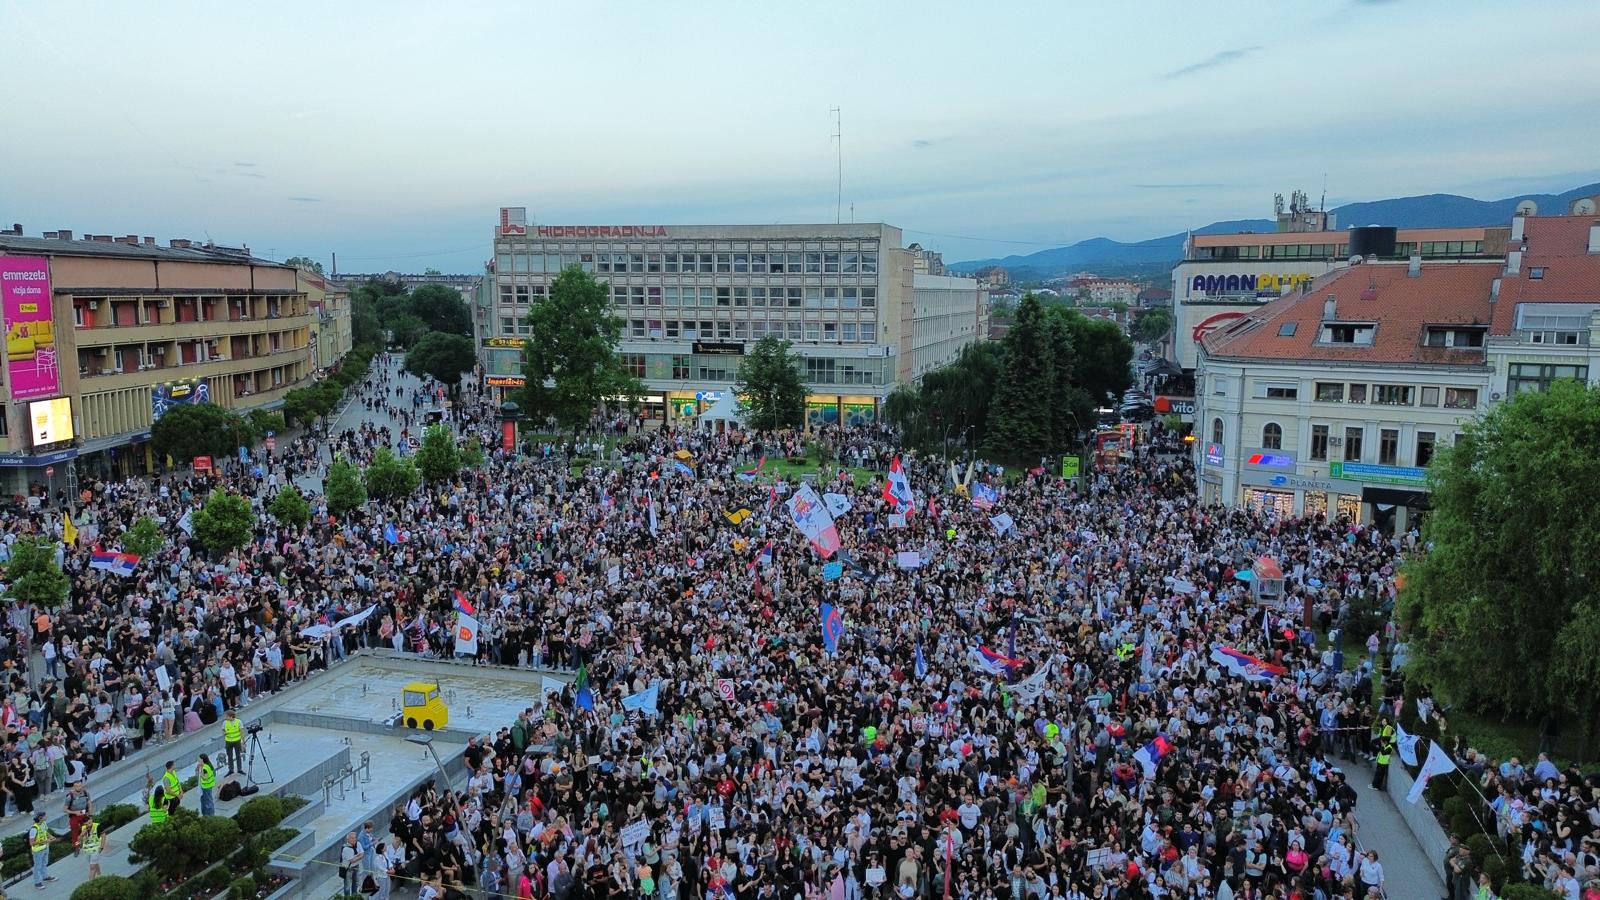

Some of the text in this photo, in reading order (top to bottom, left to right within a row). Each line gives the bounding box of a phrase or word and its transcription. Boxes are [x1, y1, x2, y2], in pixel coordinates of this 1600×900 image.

[538, 226, 667, 237] HIDROGRADNJA
[2, 270, 46, 280] emmezeta
[1192, 274, 1256, 291] AMAN
[1290, 479, 1332, 490] PLANETA
